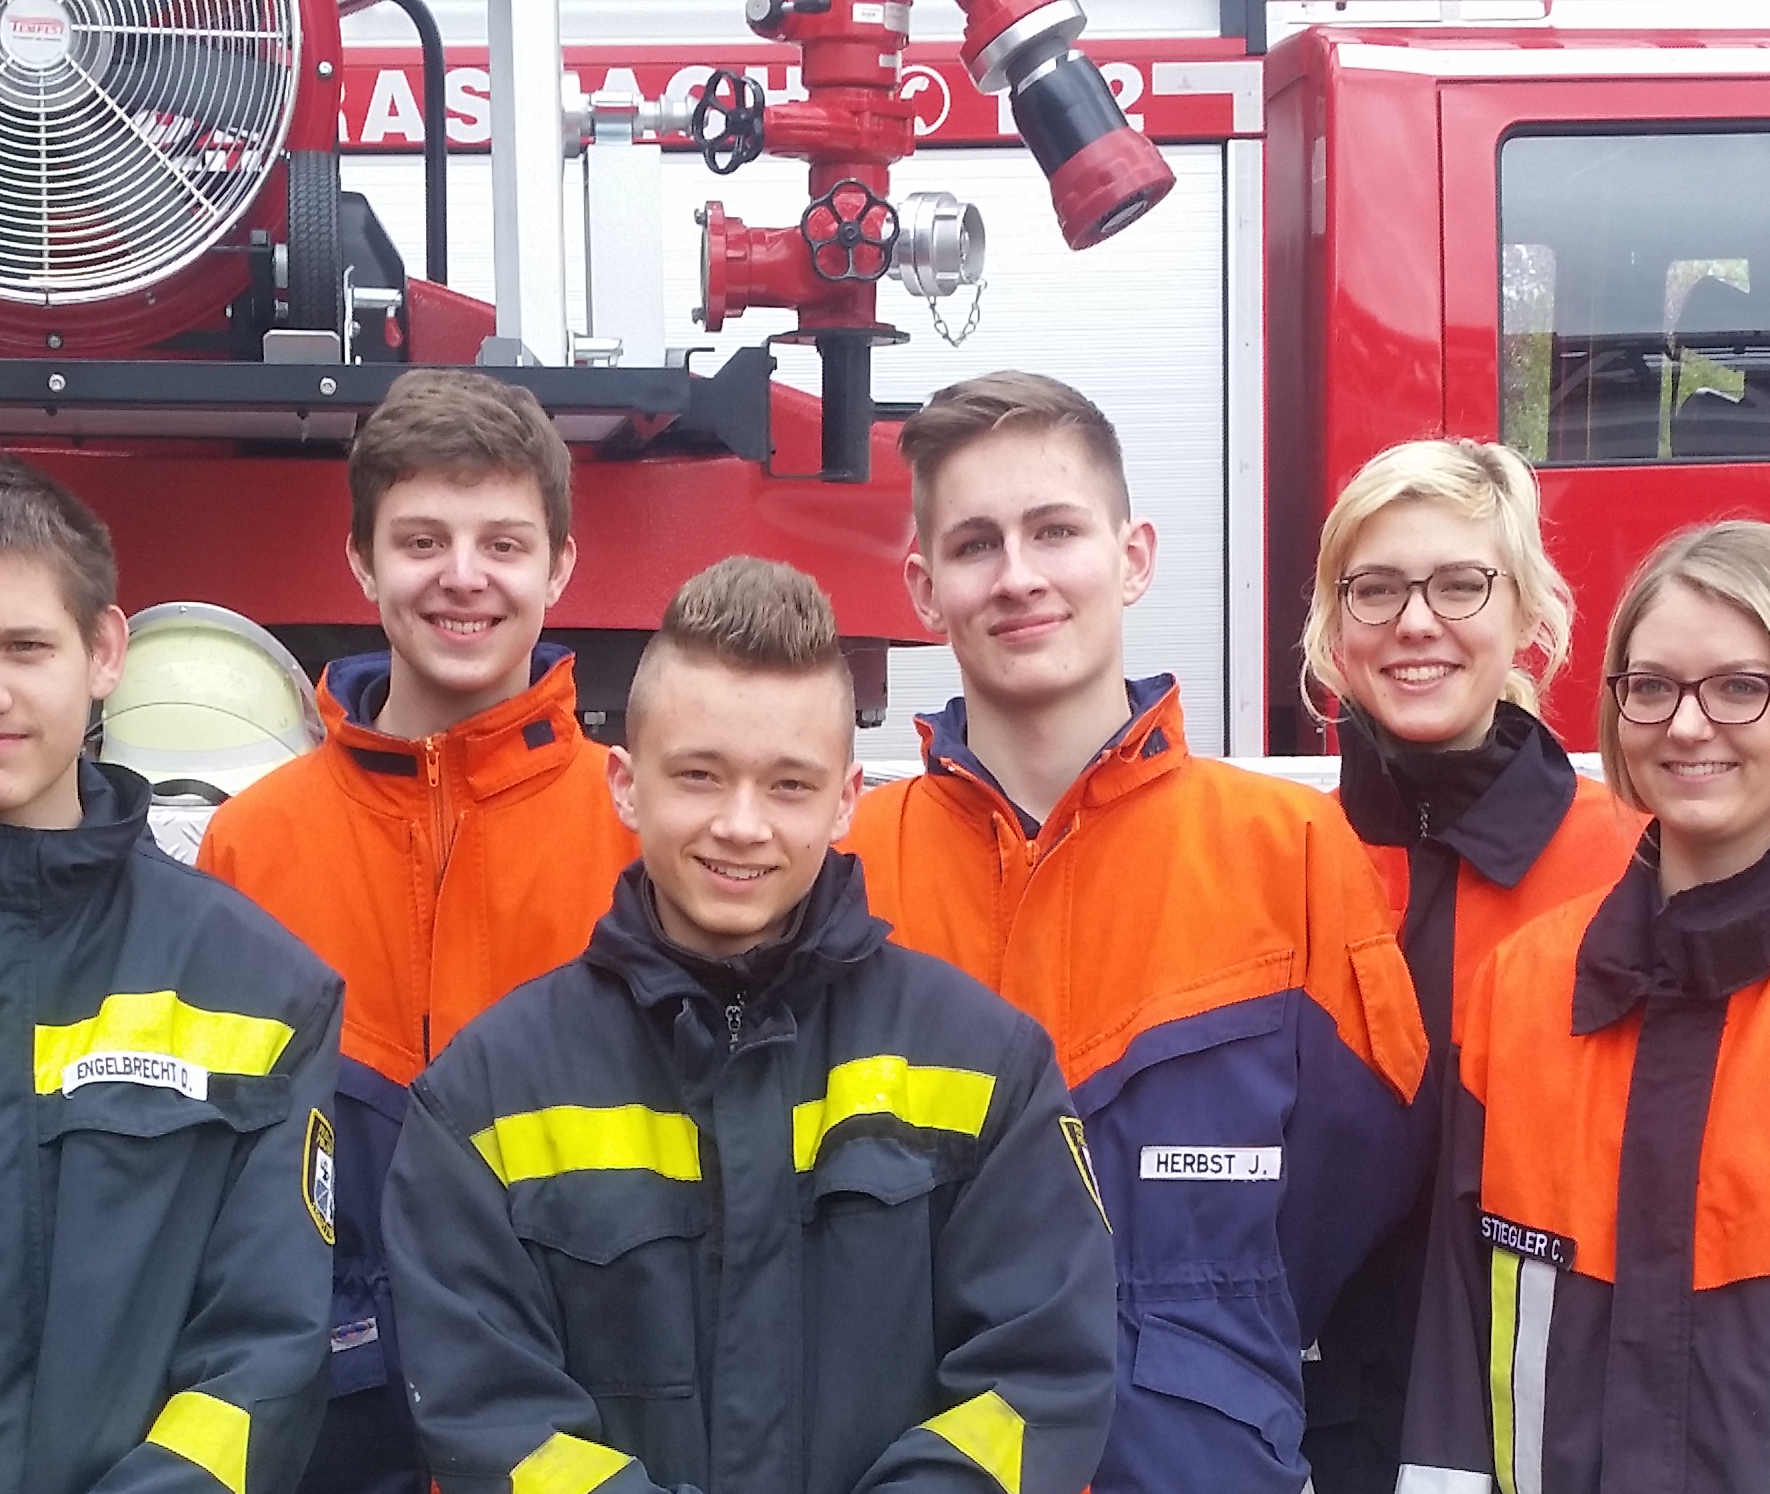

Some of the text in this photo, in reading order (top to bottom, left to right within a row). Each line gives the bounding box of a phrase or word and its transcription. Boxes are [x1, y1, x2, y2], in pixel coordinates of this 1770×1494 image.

[77, 1056, 177, 1083] ENGELBRECHT
[1156, 1153, 1267, 1176] HERBST J.
[1481, 1215, 1564, 1264] STIEGLER C.
